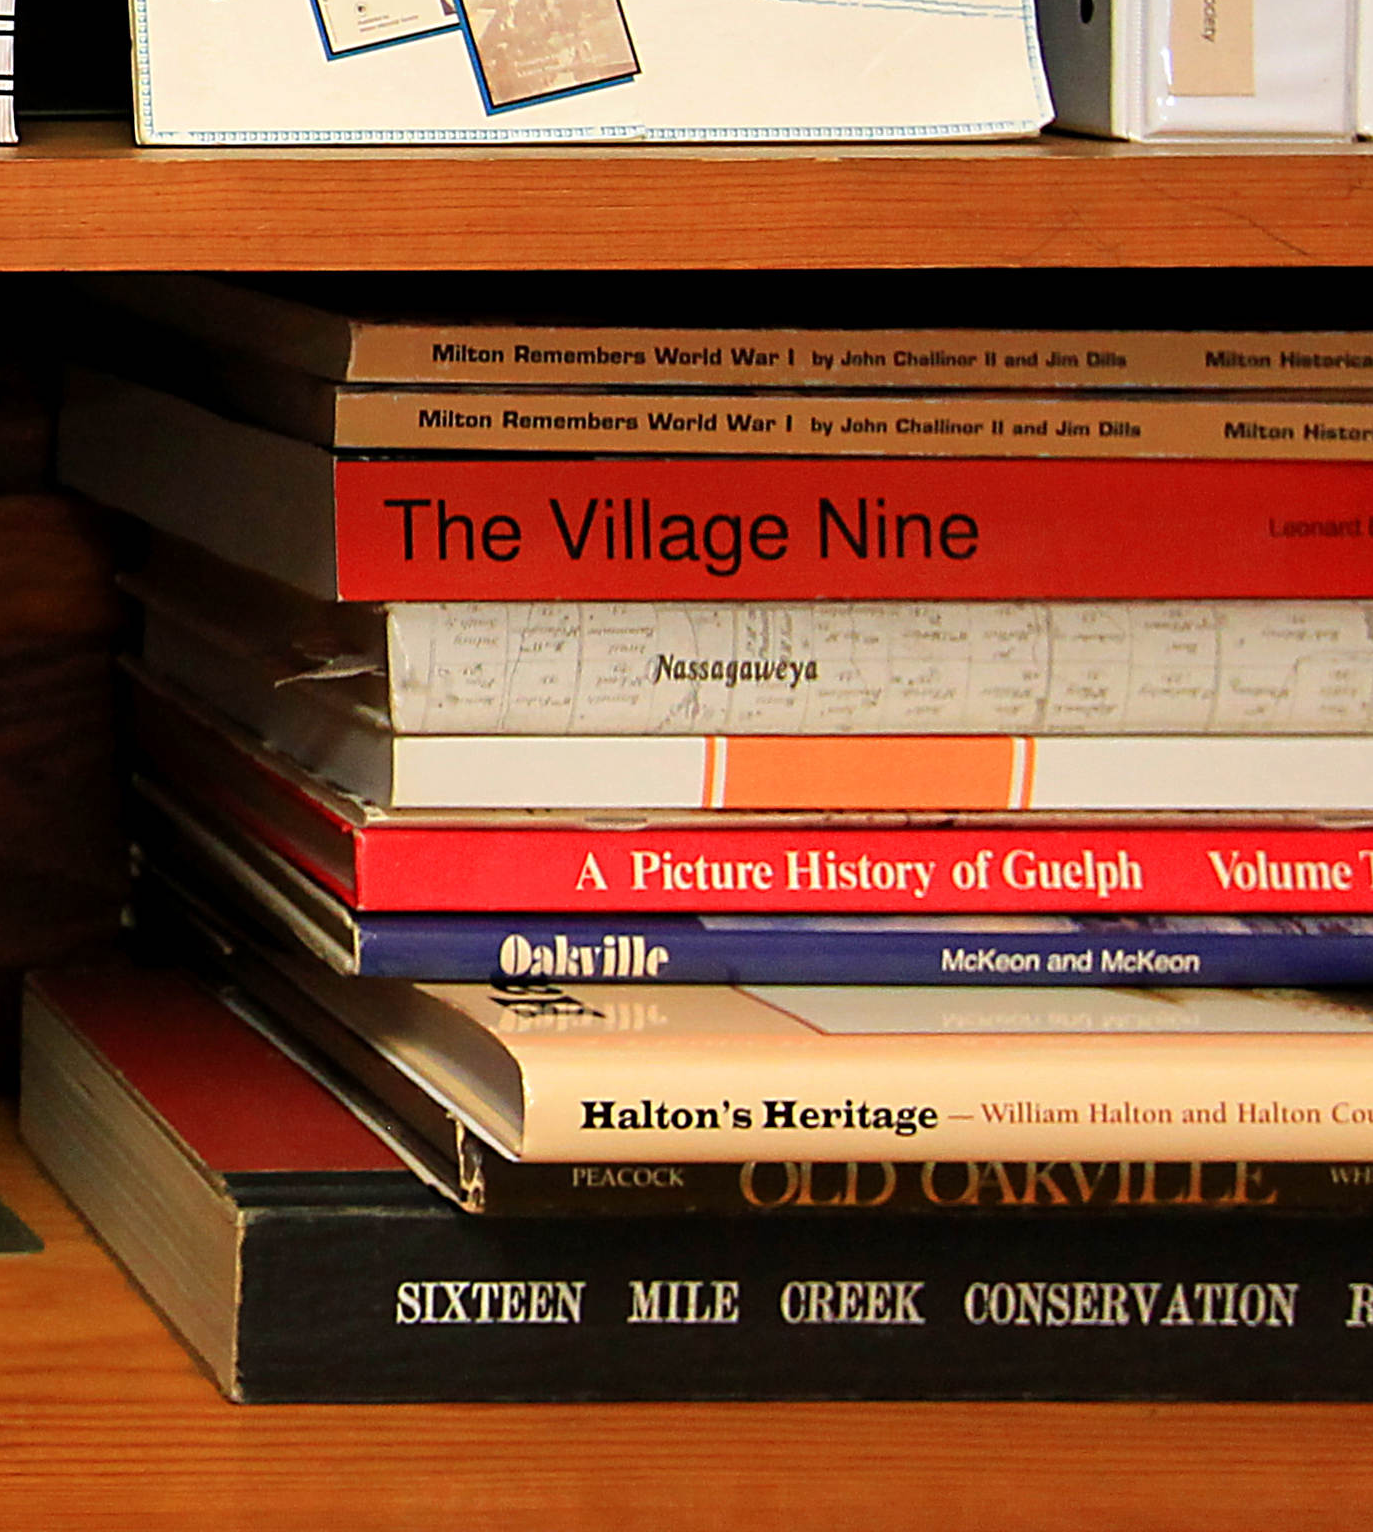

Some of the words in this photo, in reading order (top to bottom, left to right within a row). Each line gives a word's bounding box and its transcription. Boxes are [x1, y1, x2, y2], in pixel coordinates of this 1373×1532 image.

[433, 345, 504, 364] Milton
[515, 346, 645, 366] Remembers
[654, 348, 721, 367] World
[731, 348, 780, 367] War
[384, 498, 521, 561] The
[550, 498, 788, 577] Village
[820, 498, 979, 560] Nine
[653, 654, 819, 687] Nassagaweya
[575, 852, 605, 890] A
[631, 850, 773, 890] Picture
[785, 850, 935, 897] History
[952, 850, 992, 890] of
[1003, 850, 1143, 898] Guelph
[1208, 850, 1352, 890] Volume
[500, 934, 669, 976] Oakville
[581, 1100, 751, 1130] Halton's
[762, 1100, 938, 1137] Heritage
[393, 1282, 586, 1324] SIXTEEN
[627, 1282, 739, 1324] MILE
[780, 1282, 925, 1325] CREEK
[965, 1283, 1298, 1328] CONSERVATION
